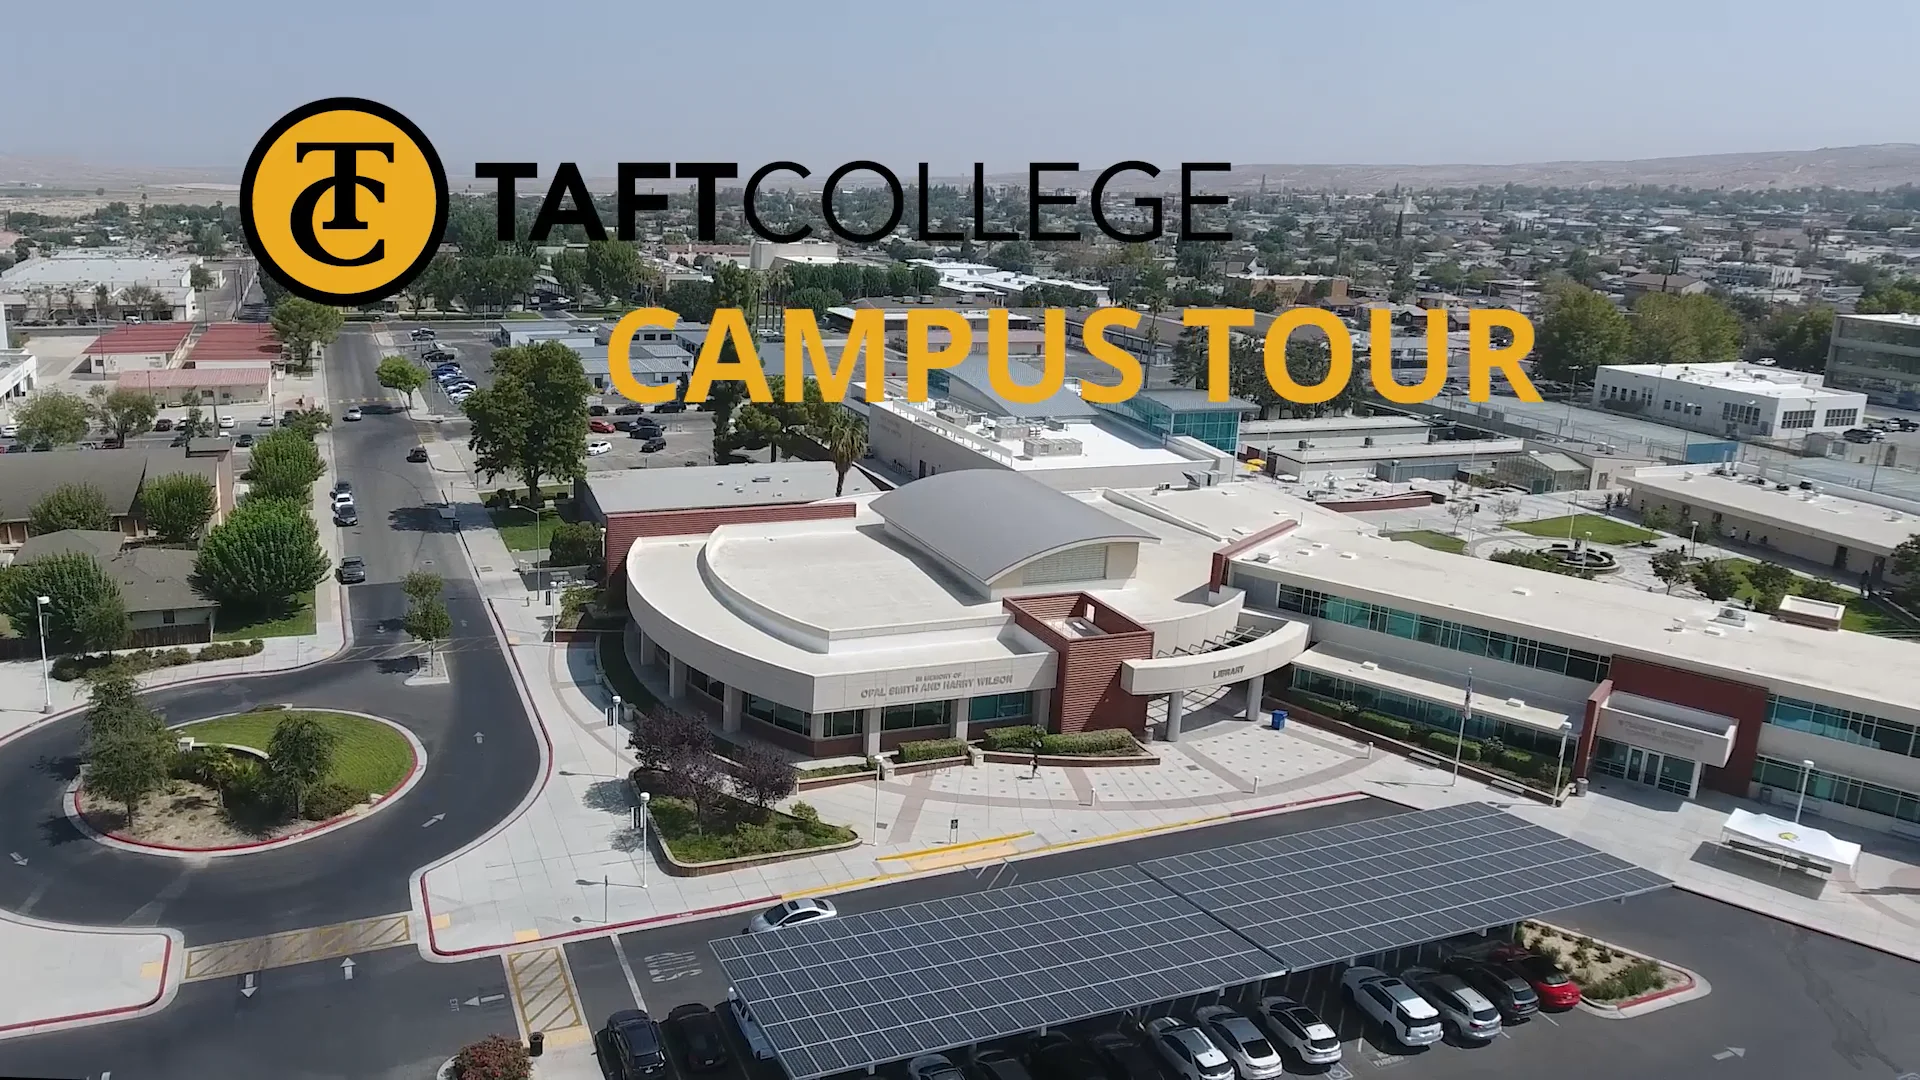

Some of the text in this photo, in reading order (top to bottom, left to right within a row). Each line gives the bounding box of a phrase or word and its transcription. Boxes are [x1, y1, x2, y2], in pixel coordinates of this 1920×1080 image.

[1213, 665, 1245, 679] LIBRARY
[860, 674, 1013, 699] OPAL SMITH AND HARRY WILSON
